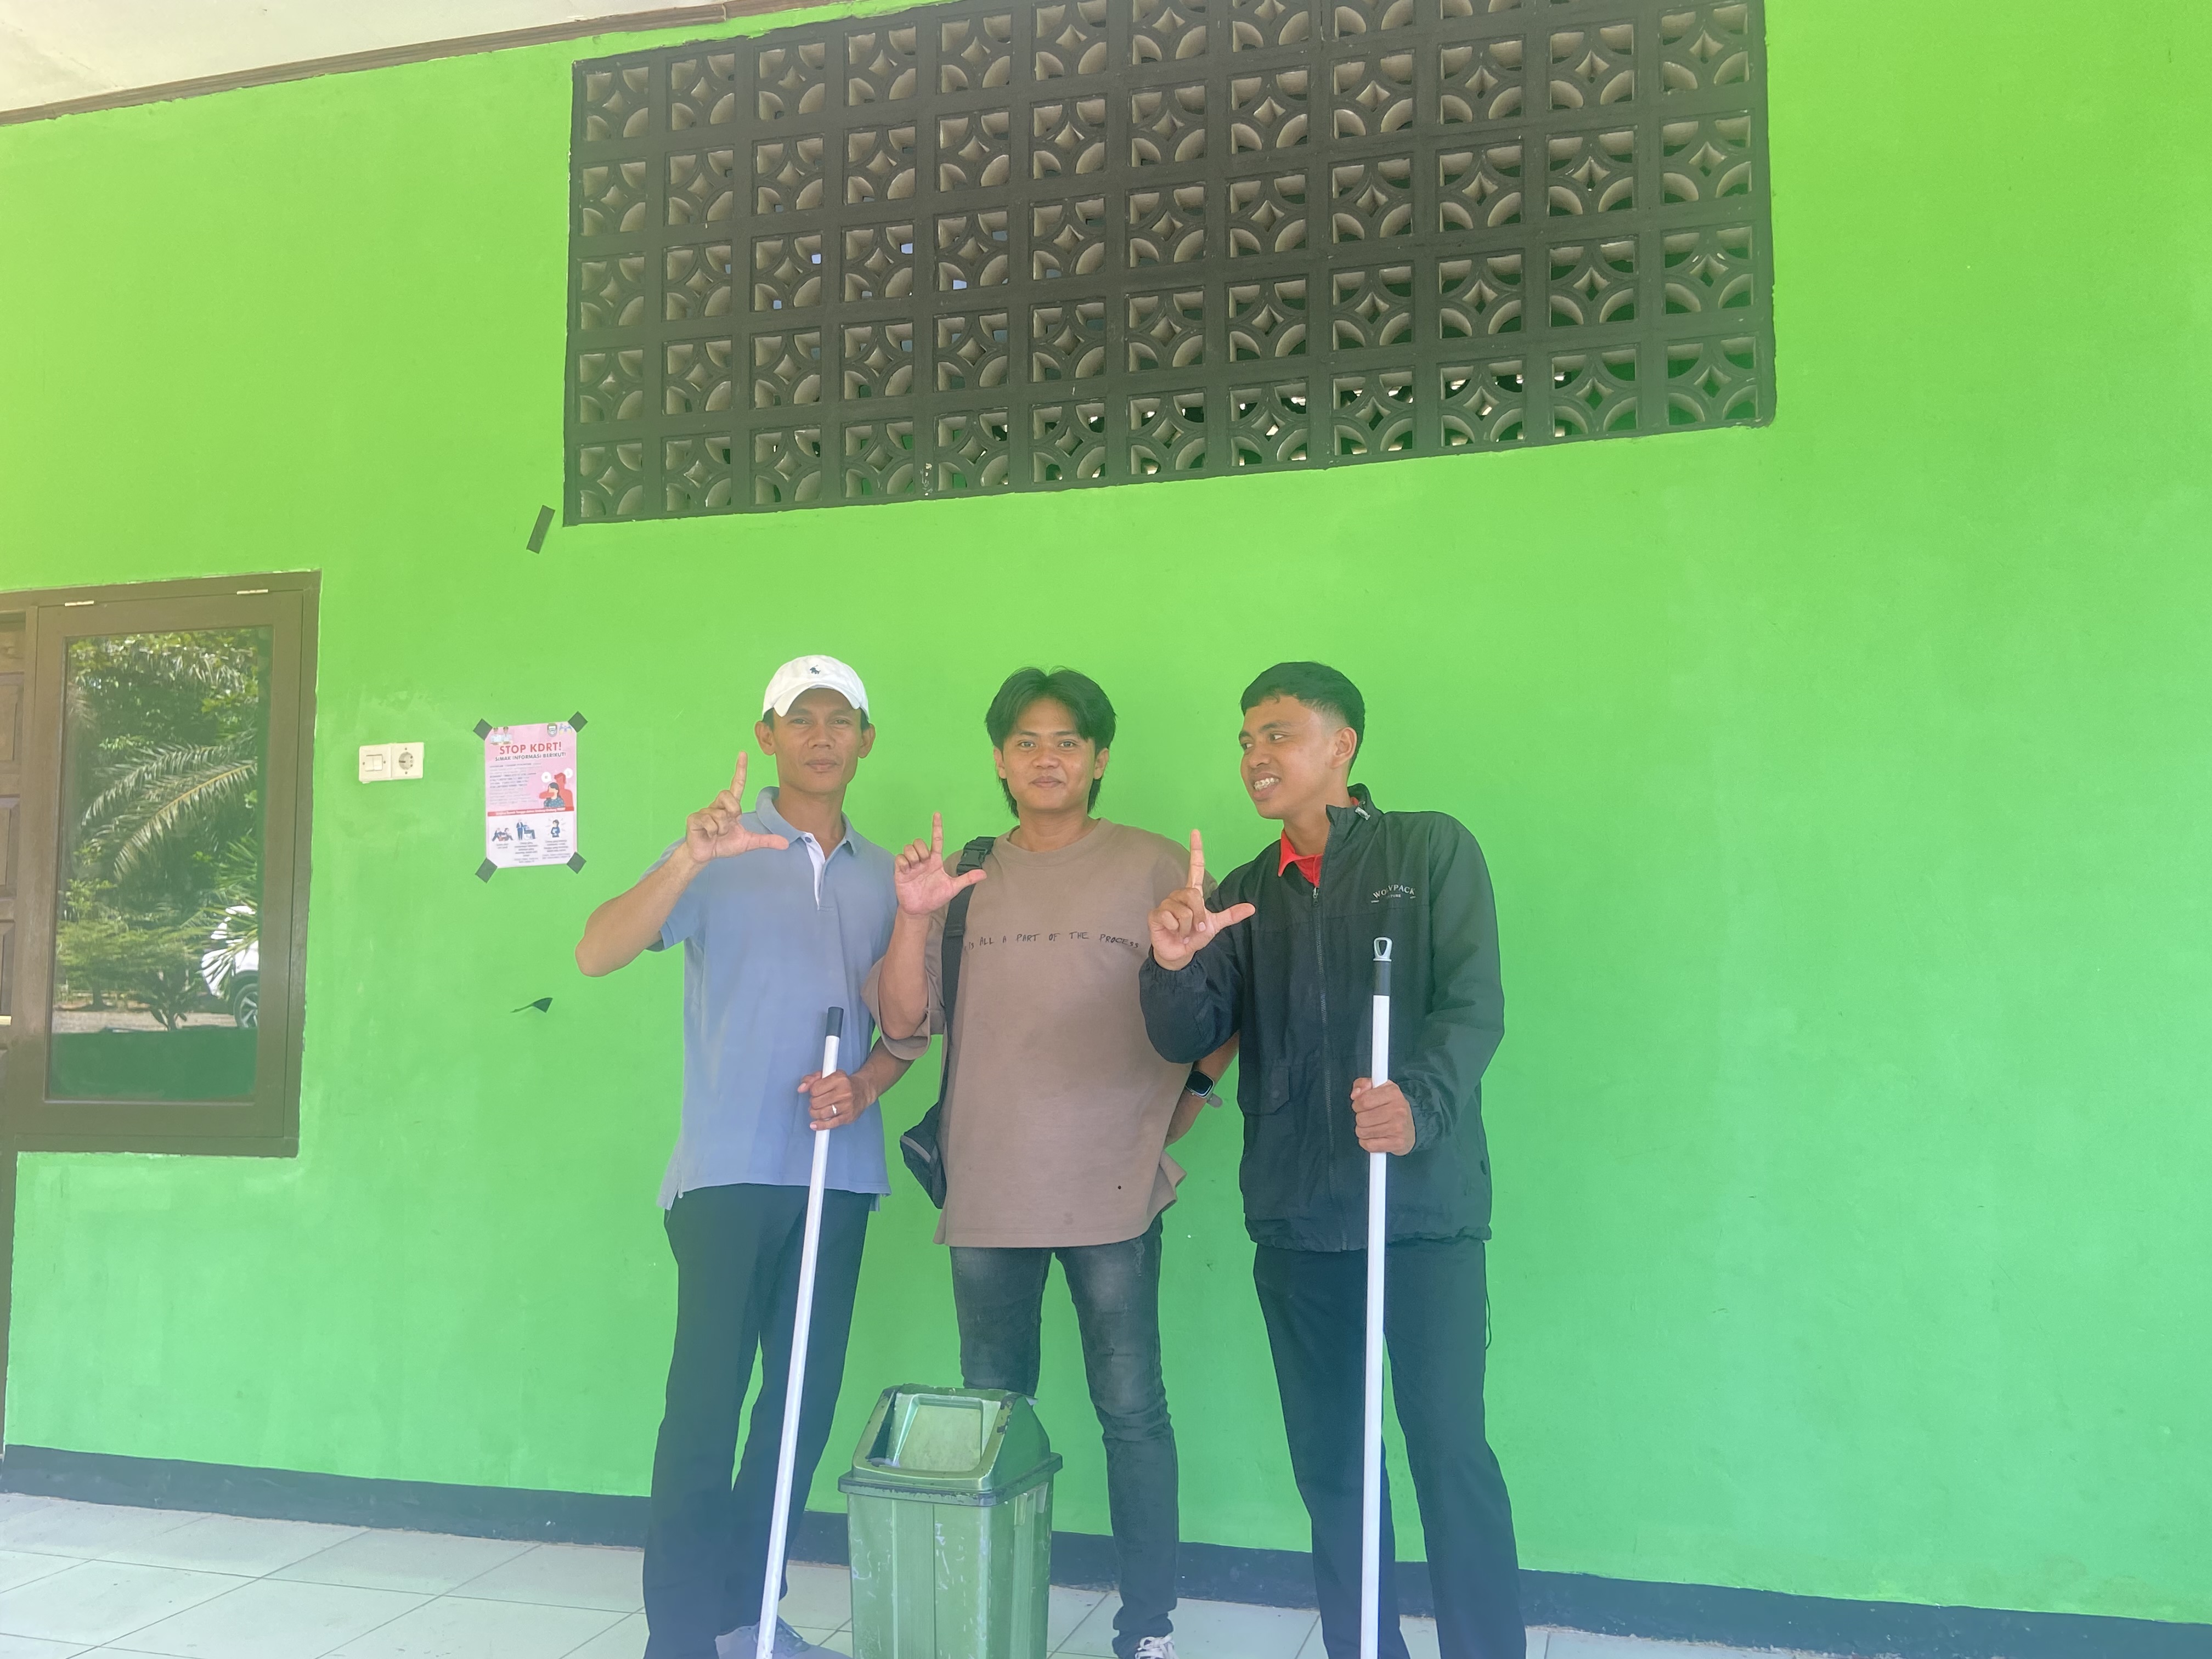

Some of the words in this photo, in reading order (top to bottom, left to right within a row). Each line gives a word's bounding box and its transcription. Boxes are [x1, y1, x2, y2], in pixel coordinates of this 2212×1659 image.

[500, 744, 526, 754] STOP
[530, 742, 561, 752] KDRT!
[1373, 884, 1415, 899] WOVPACK
[979, 936, 994, 946] ALL
[1017, 934, 1040, 942] PART
[1048, 933, 1060, 941] OF
[1099, 934, 1139, 948] PROCESS
